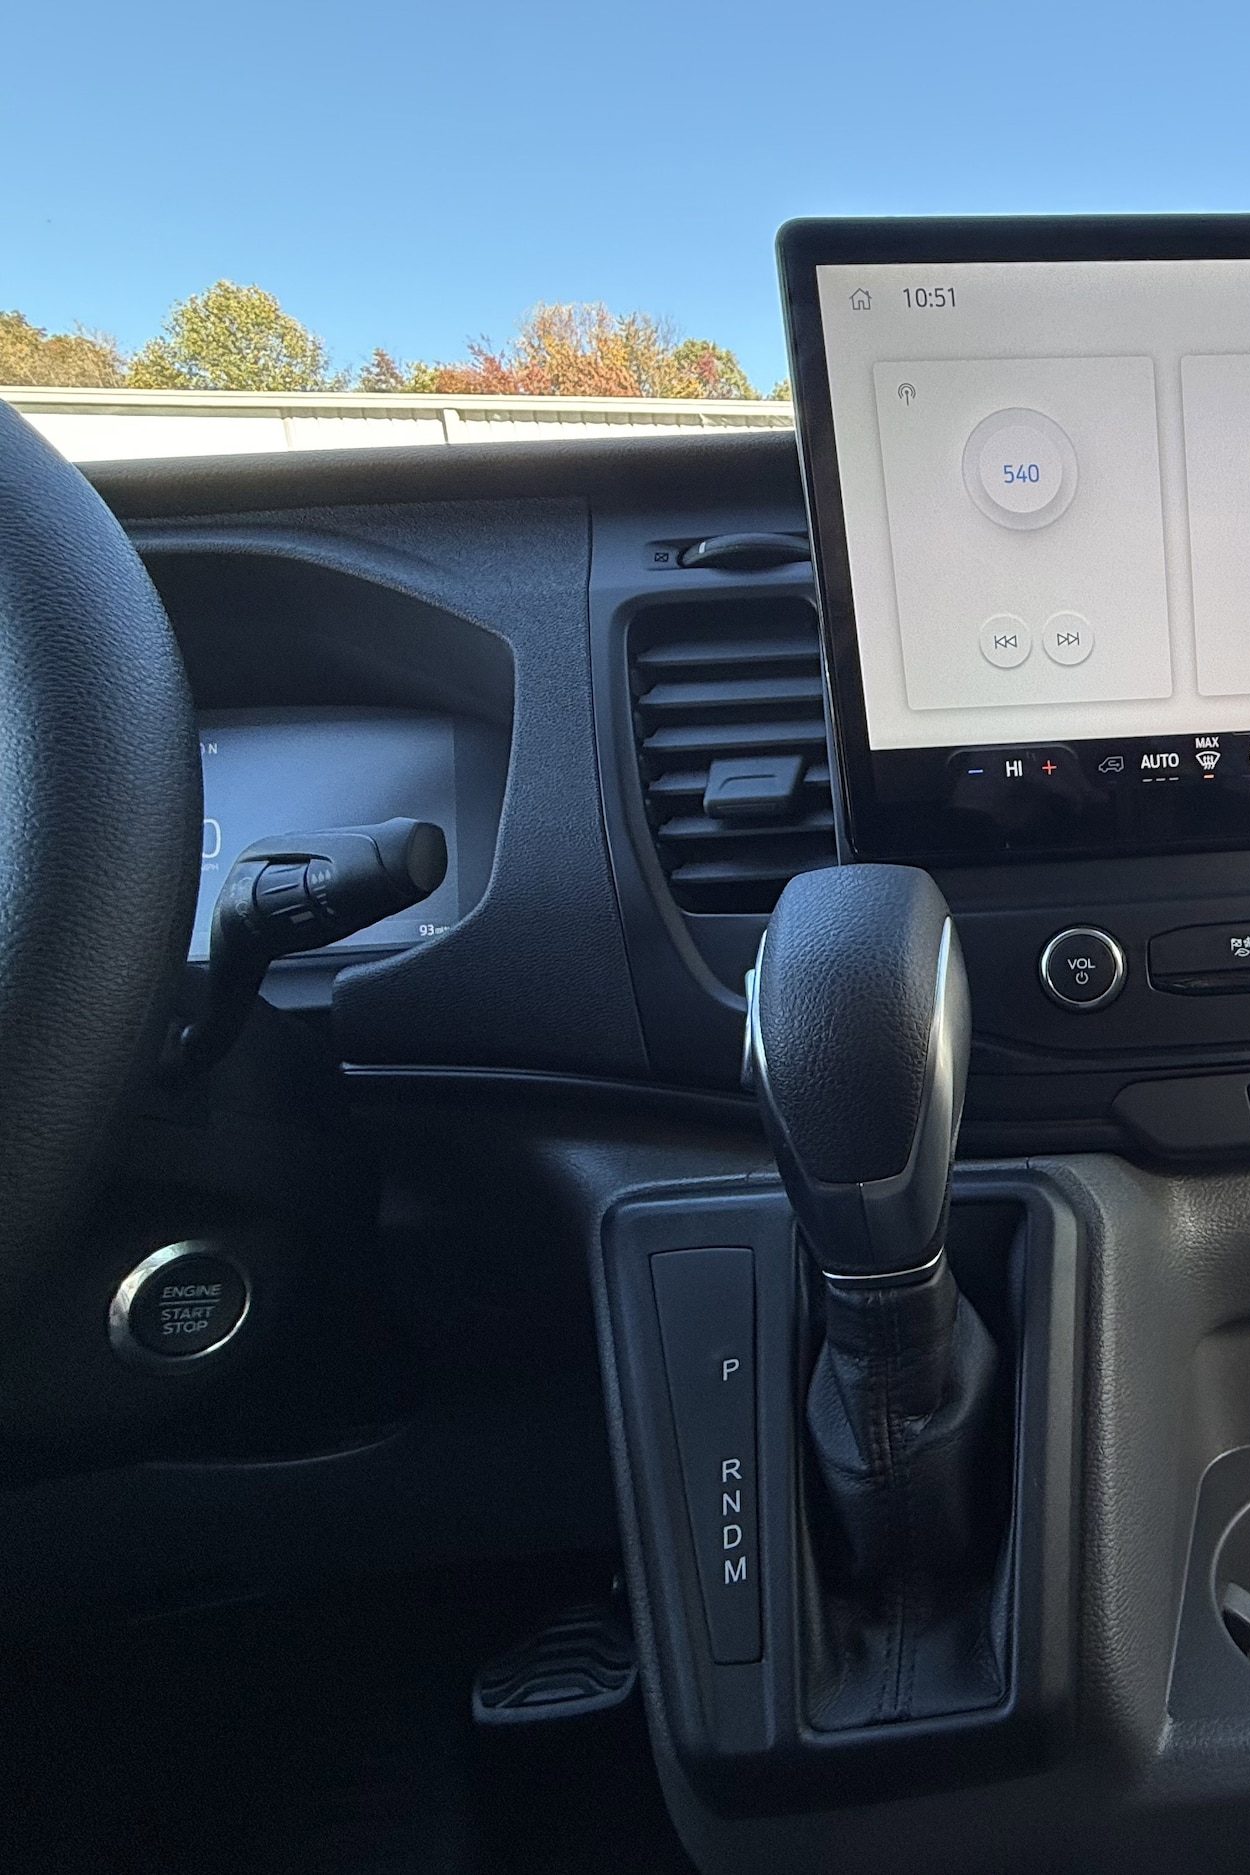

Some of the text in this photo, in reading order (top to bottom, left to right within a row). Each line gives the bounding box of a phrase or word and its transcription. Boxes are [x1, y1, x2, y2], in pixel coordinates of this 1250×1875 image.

[902, 287, 957, 308] 10:51
[1003, 463, 1040, 485] 540
[1195, 736, 1219, 749] MAX
[1005, 760, 1023, 777] HI
[1140, 753, 1179, 770] AUTO
[1067, 958, 1096, 970] VOL
[161, 1283, 222, 1299] ENGINE
[160, 1305, 215, 1321] START
[162, 1320, 209, 1335] STOP
[722, 1358, 740, 1381] P
[722, 1458, 742, 1482] R
[722, 1489, 741, 1516] N
[723, 1523, 742, 1550] D
[724, 1556, 747, 1584] M
